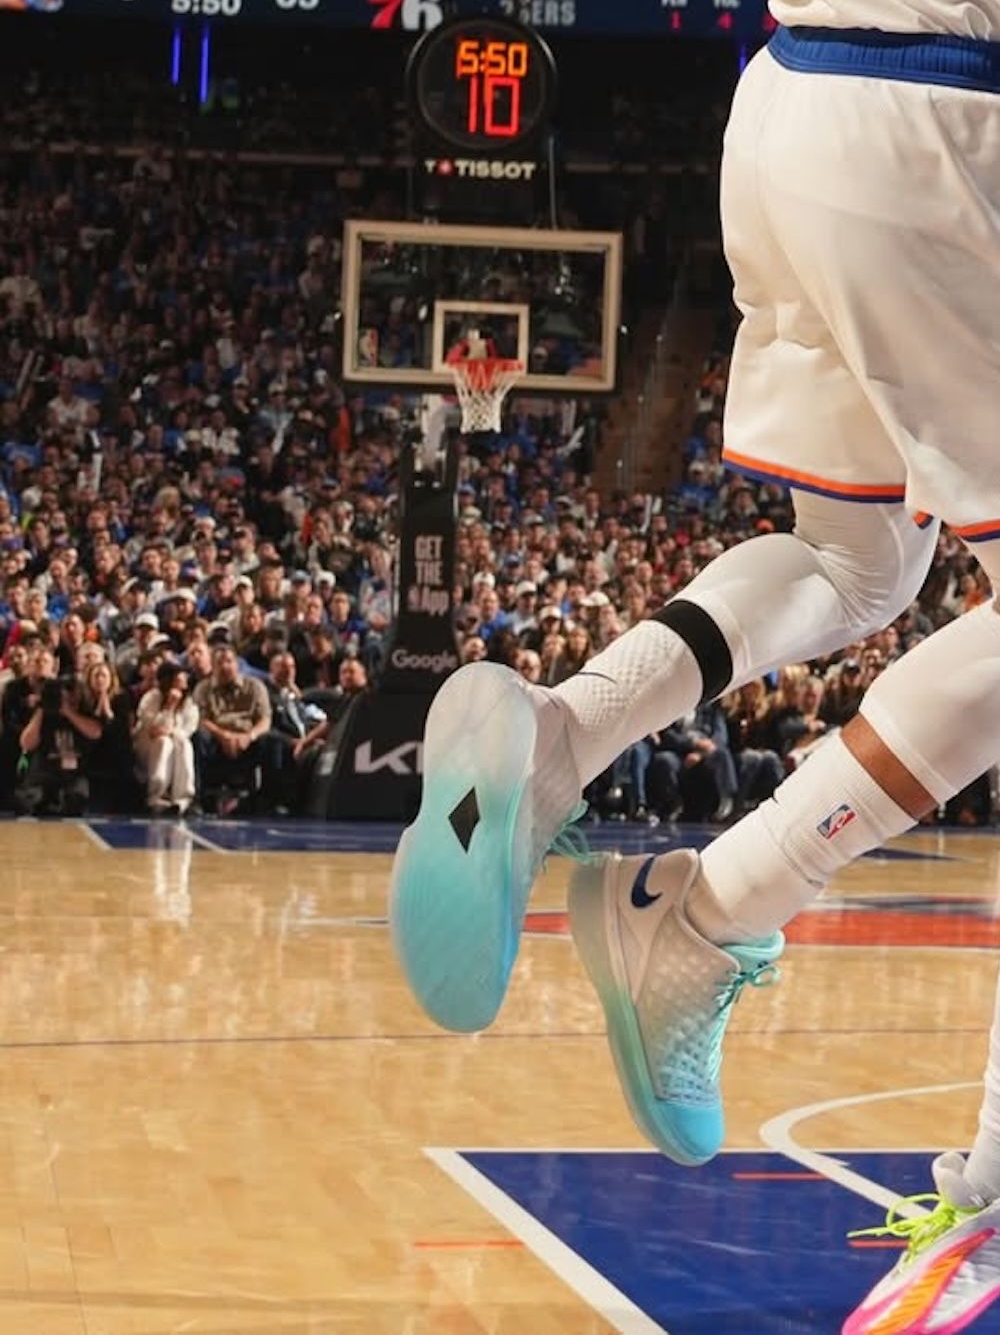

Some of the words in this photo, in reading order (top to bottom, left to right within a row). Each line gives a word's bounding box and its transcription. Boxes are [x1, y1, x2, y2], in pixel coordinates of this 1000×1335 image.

[457, 40, 528, 78] 5:50
[468, 75, 520, 135] 10
[455, 159, 536, 180] TISSOT
[415, 535, 442, 560] GET
[415, 561, 442, 584] THE
[391, 649, 458, 673] Google
